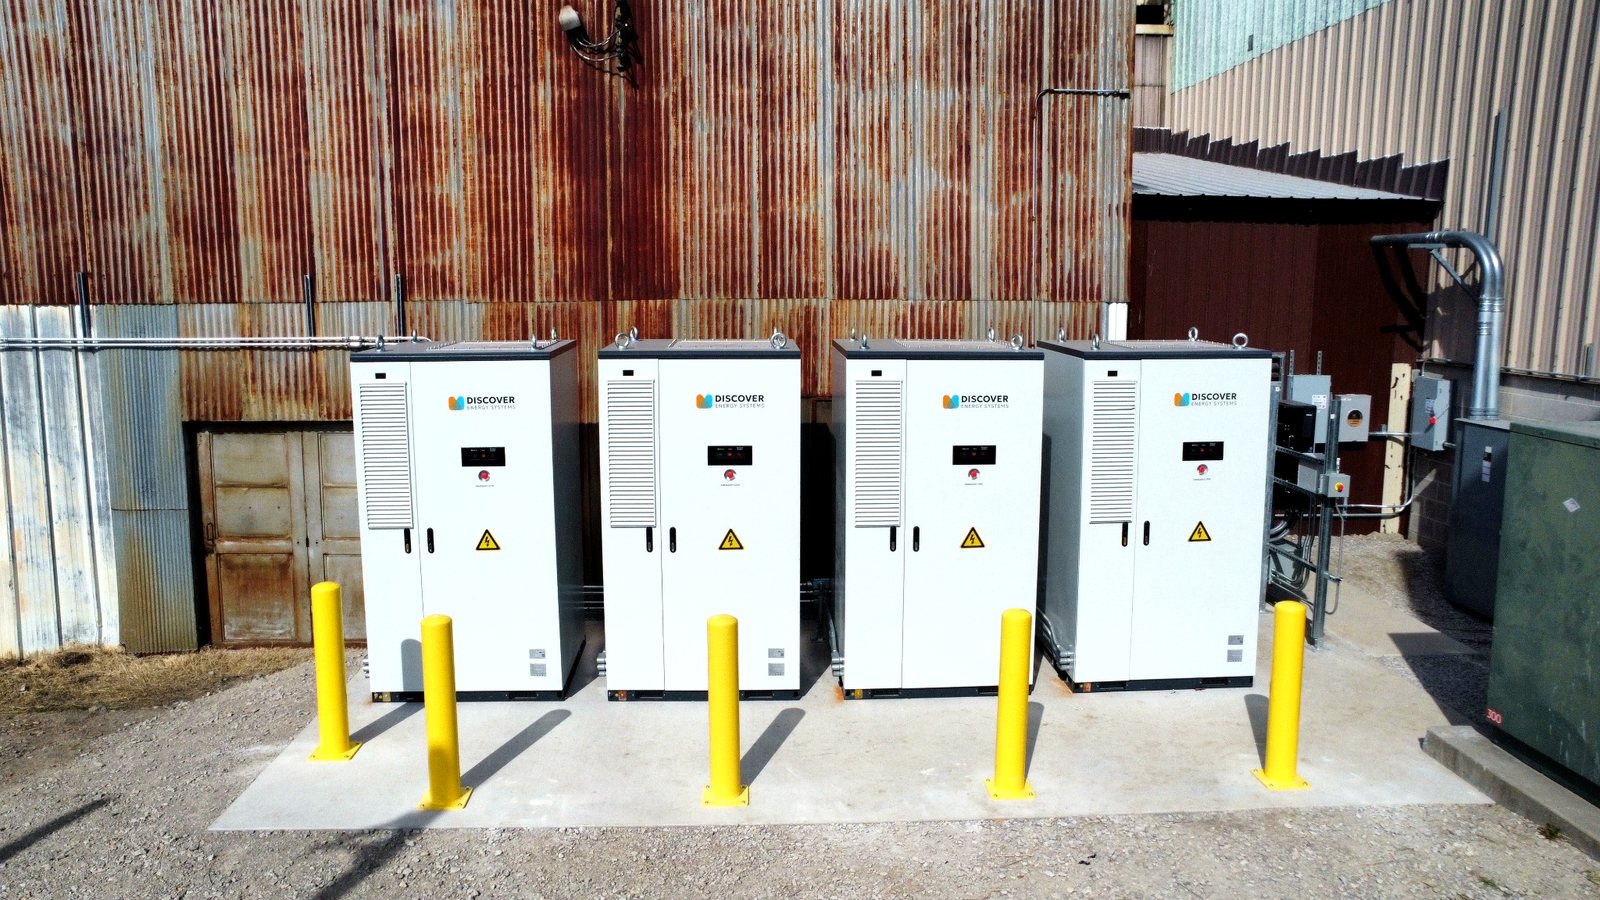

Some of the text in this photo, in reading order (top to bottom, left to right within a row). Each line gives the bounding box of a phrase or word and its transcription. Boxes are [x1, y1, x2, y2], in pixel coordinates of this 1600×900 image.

[466, 396, 515, 404] DISCOVER
[715, 394, 765, 403] DISCOVER
[961, 395, 1009, 403] DISCOVER
[1191, 393, 1237, 401] DISCOVER
[1485, 708, 1502, 724] 300
